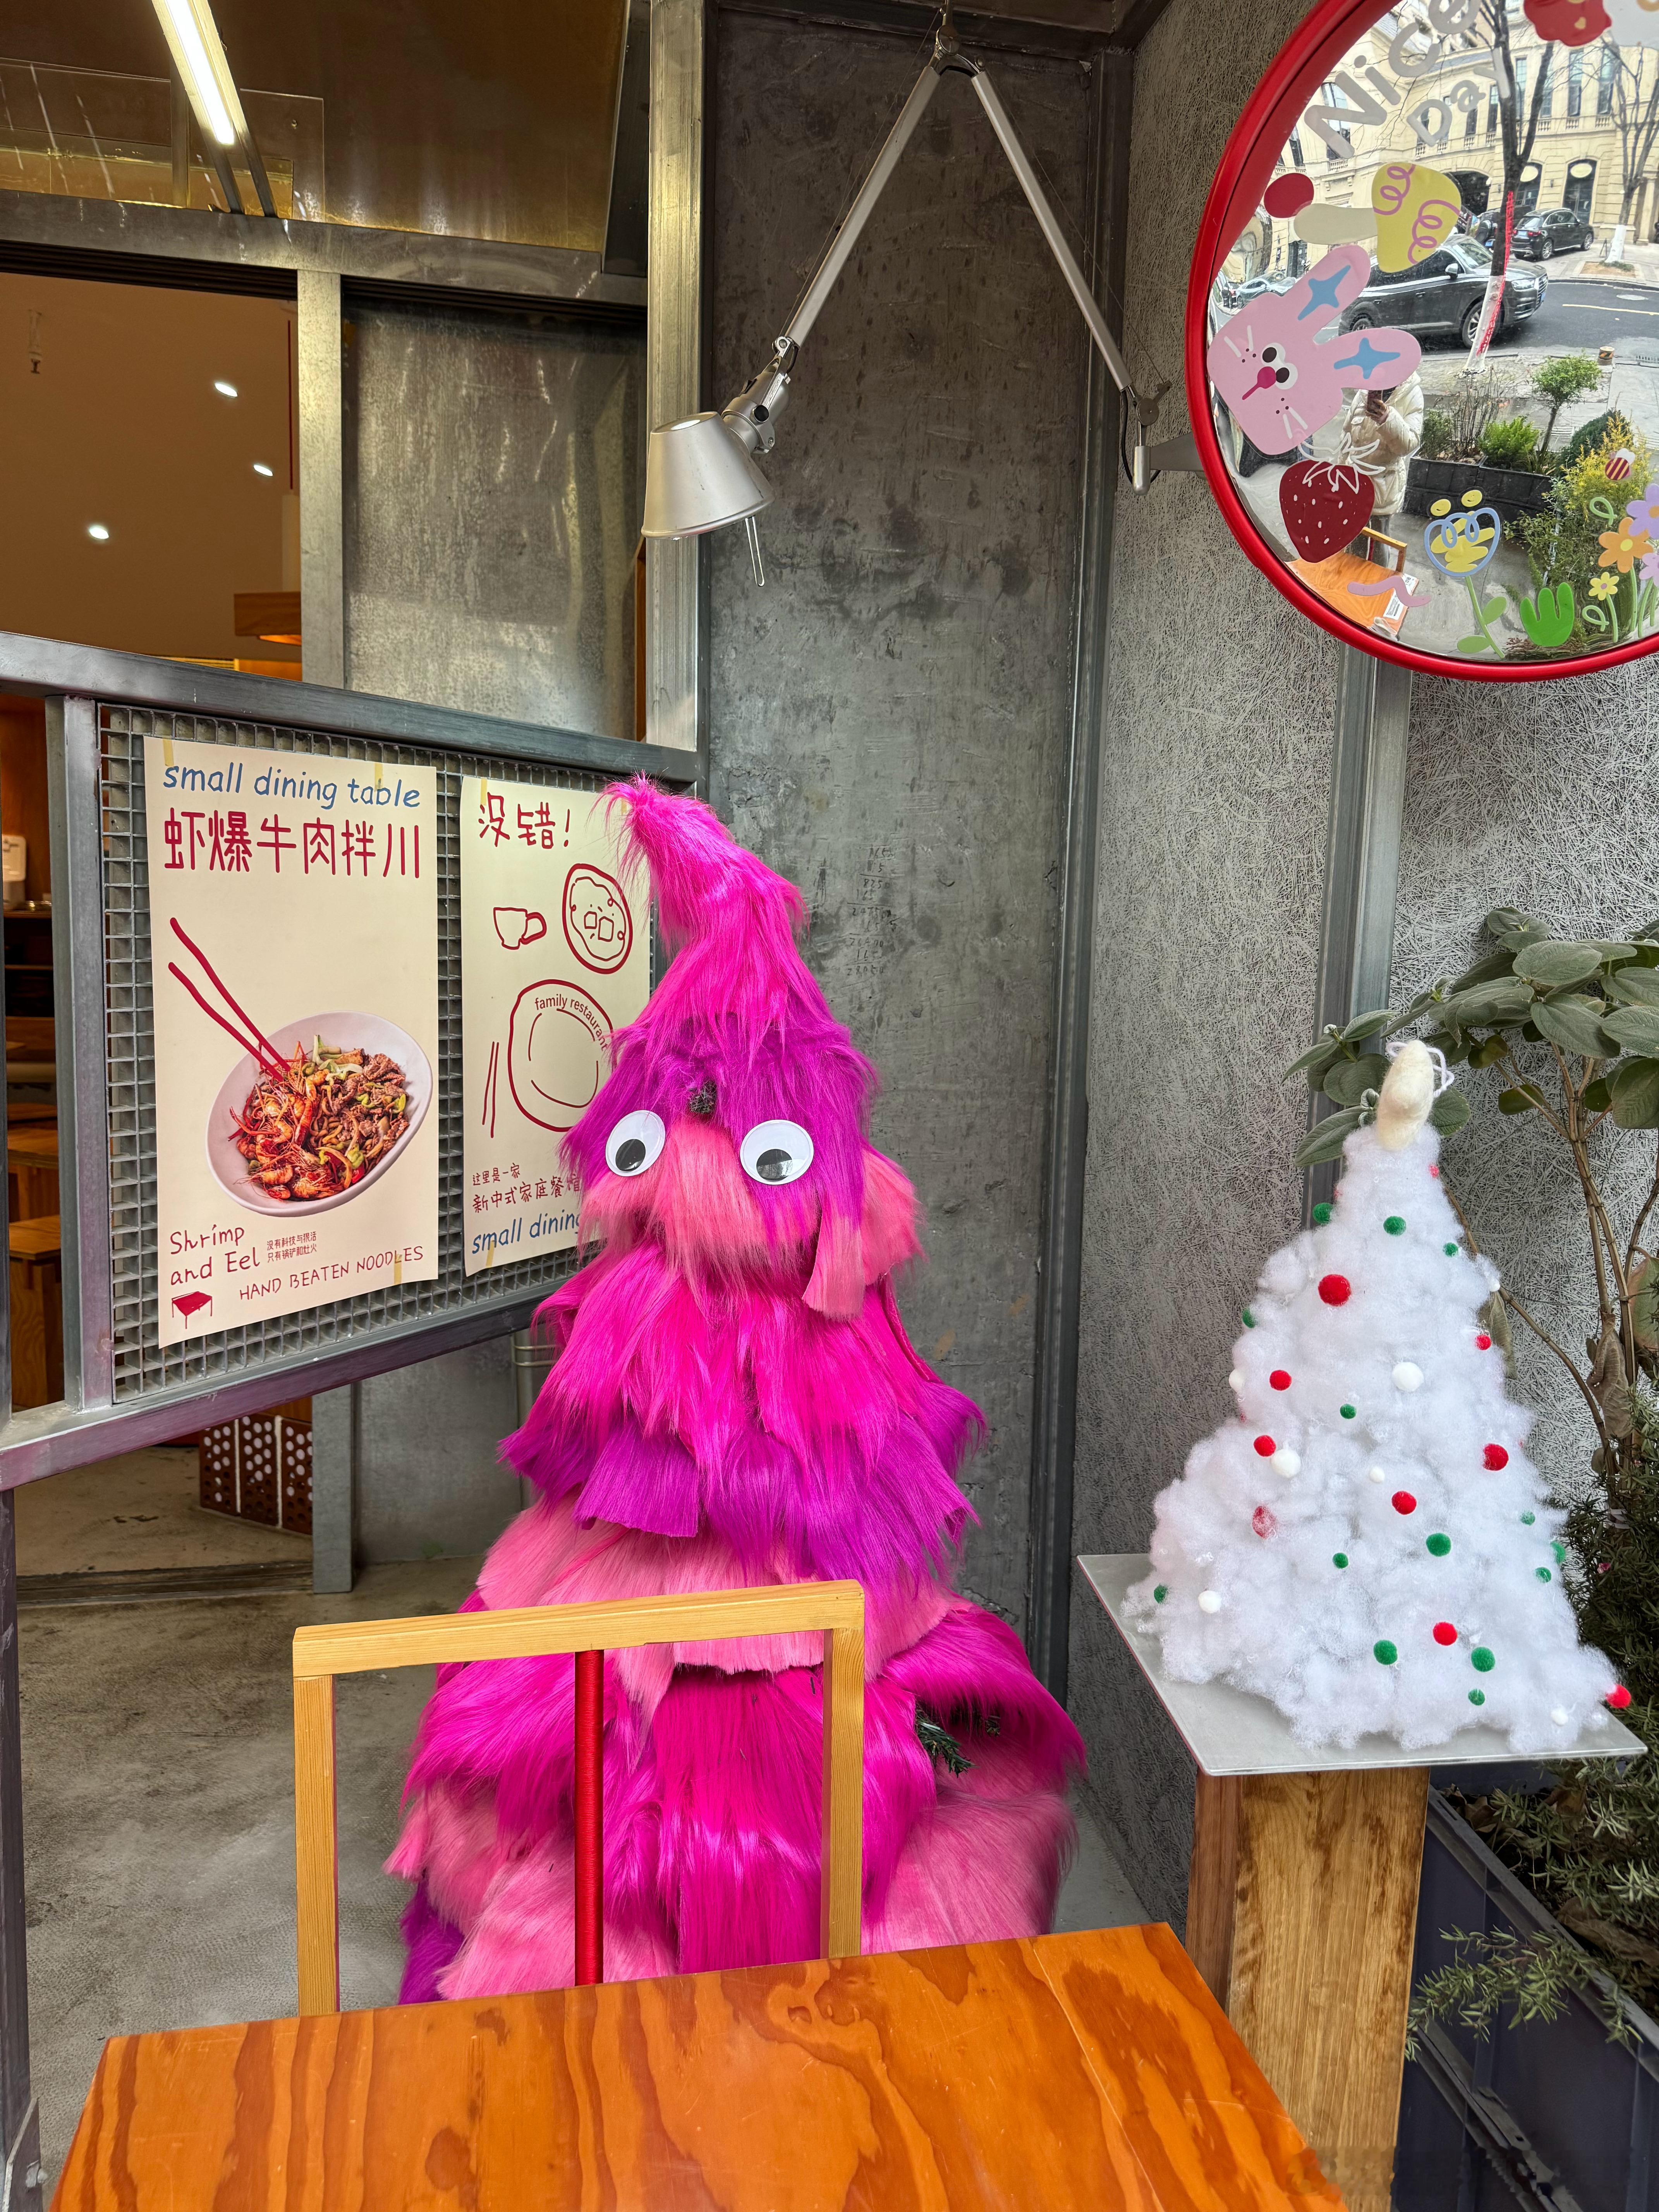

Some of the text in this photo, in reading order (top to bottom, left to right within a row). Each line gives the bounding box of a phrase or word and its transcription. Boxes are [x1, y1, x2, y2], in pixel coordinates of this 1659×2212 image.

[1304, 0, 1480, 159] Nice
[1407, 47, 1510, 147] Day
[163, 762, 421, 810] small dining table
[164, 807, 420, 878] 虾爆牛肉拌川
[535, 994, 608, 1051] family restaurant
[472, 1162, 520, 1186] 这里是一家
[170, 1224, 244, 1255] Shrimp
[267, 1231, 317, 1251] 没有科技与狠活
[267, 1243, 317, 1263] 只有锅铲和灶火
[472, 1218, 522, 1254] small
[170, 1247, 260, 1286] and Eel
[240, 1246, 423, 1300] HAND BEATEN NOODLES
